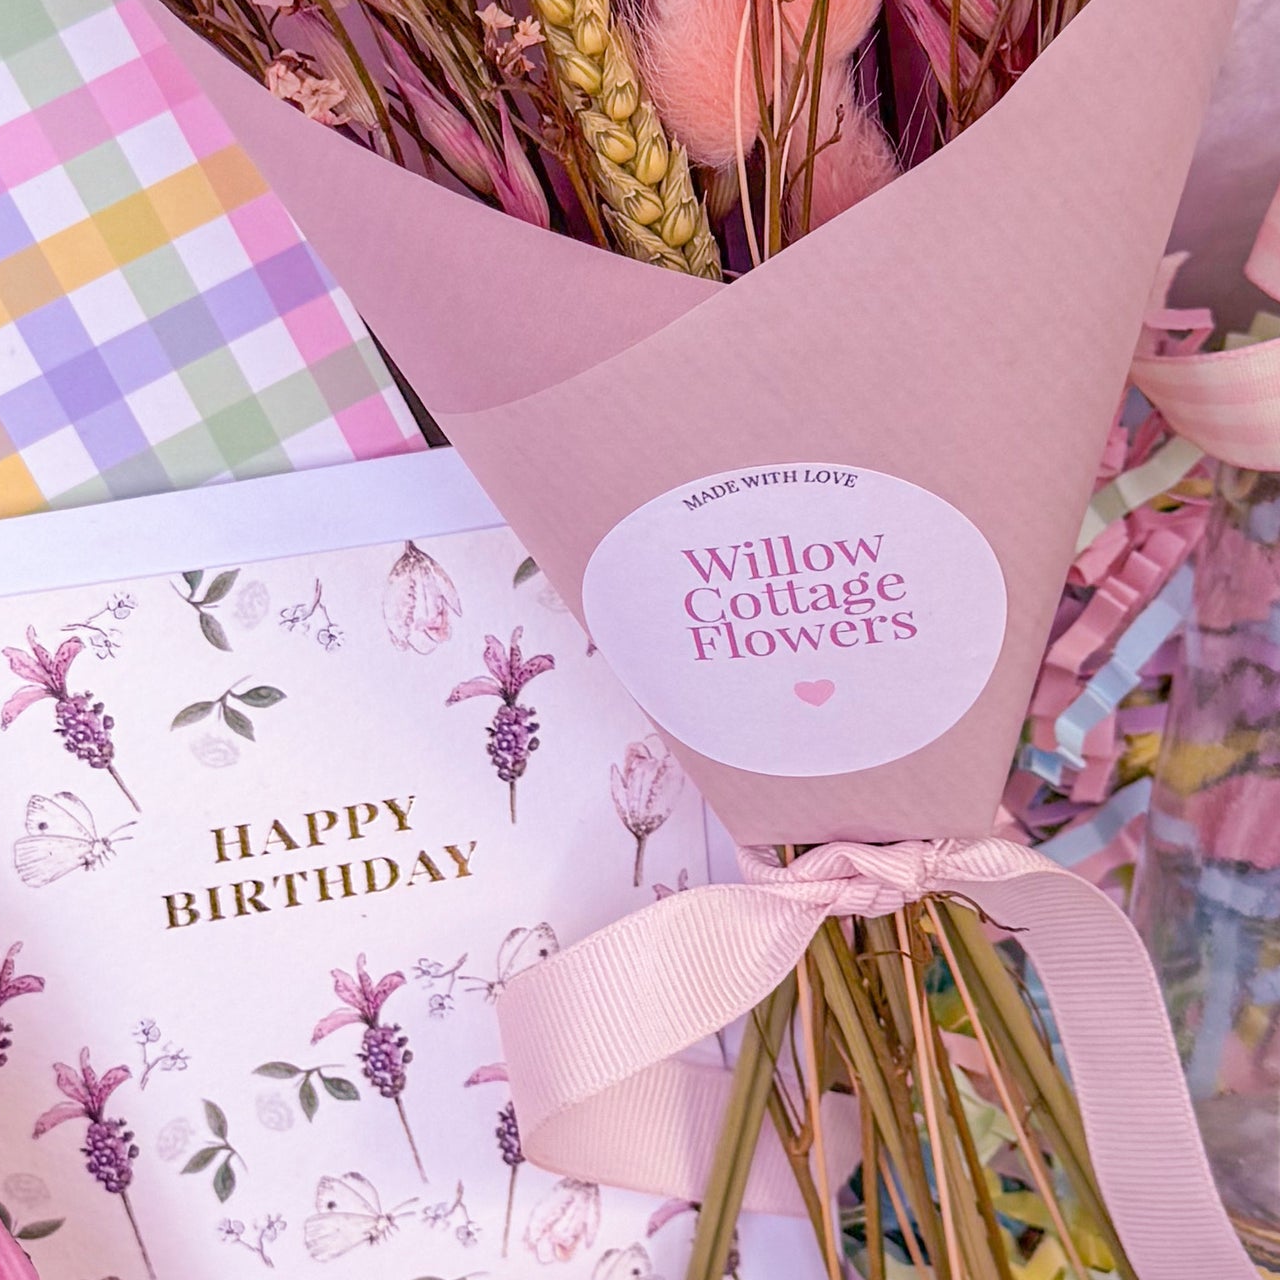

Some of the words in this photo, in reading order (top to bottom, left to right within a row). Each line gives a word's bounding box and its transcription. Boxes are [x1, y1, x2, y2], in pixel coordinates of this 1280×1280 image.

[682, 480, 739, 511] MADE
[741, 470, 798, 489] WITH
[803, 470, 859, 489] LOVE
[680, 534, 885, 584] Willow
[683, 571, 907, 623] Cottage
[686, 610, 918, 661] Flowers
[210, 795, 416, 863] HAPPY
[161, 840, 477, 930] BIRTHDAY
